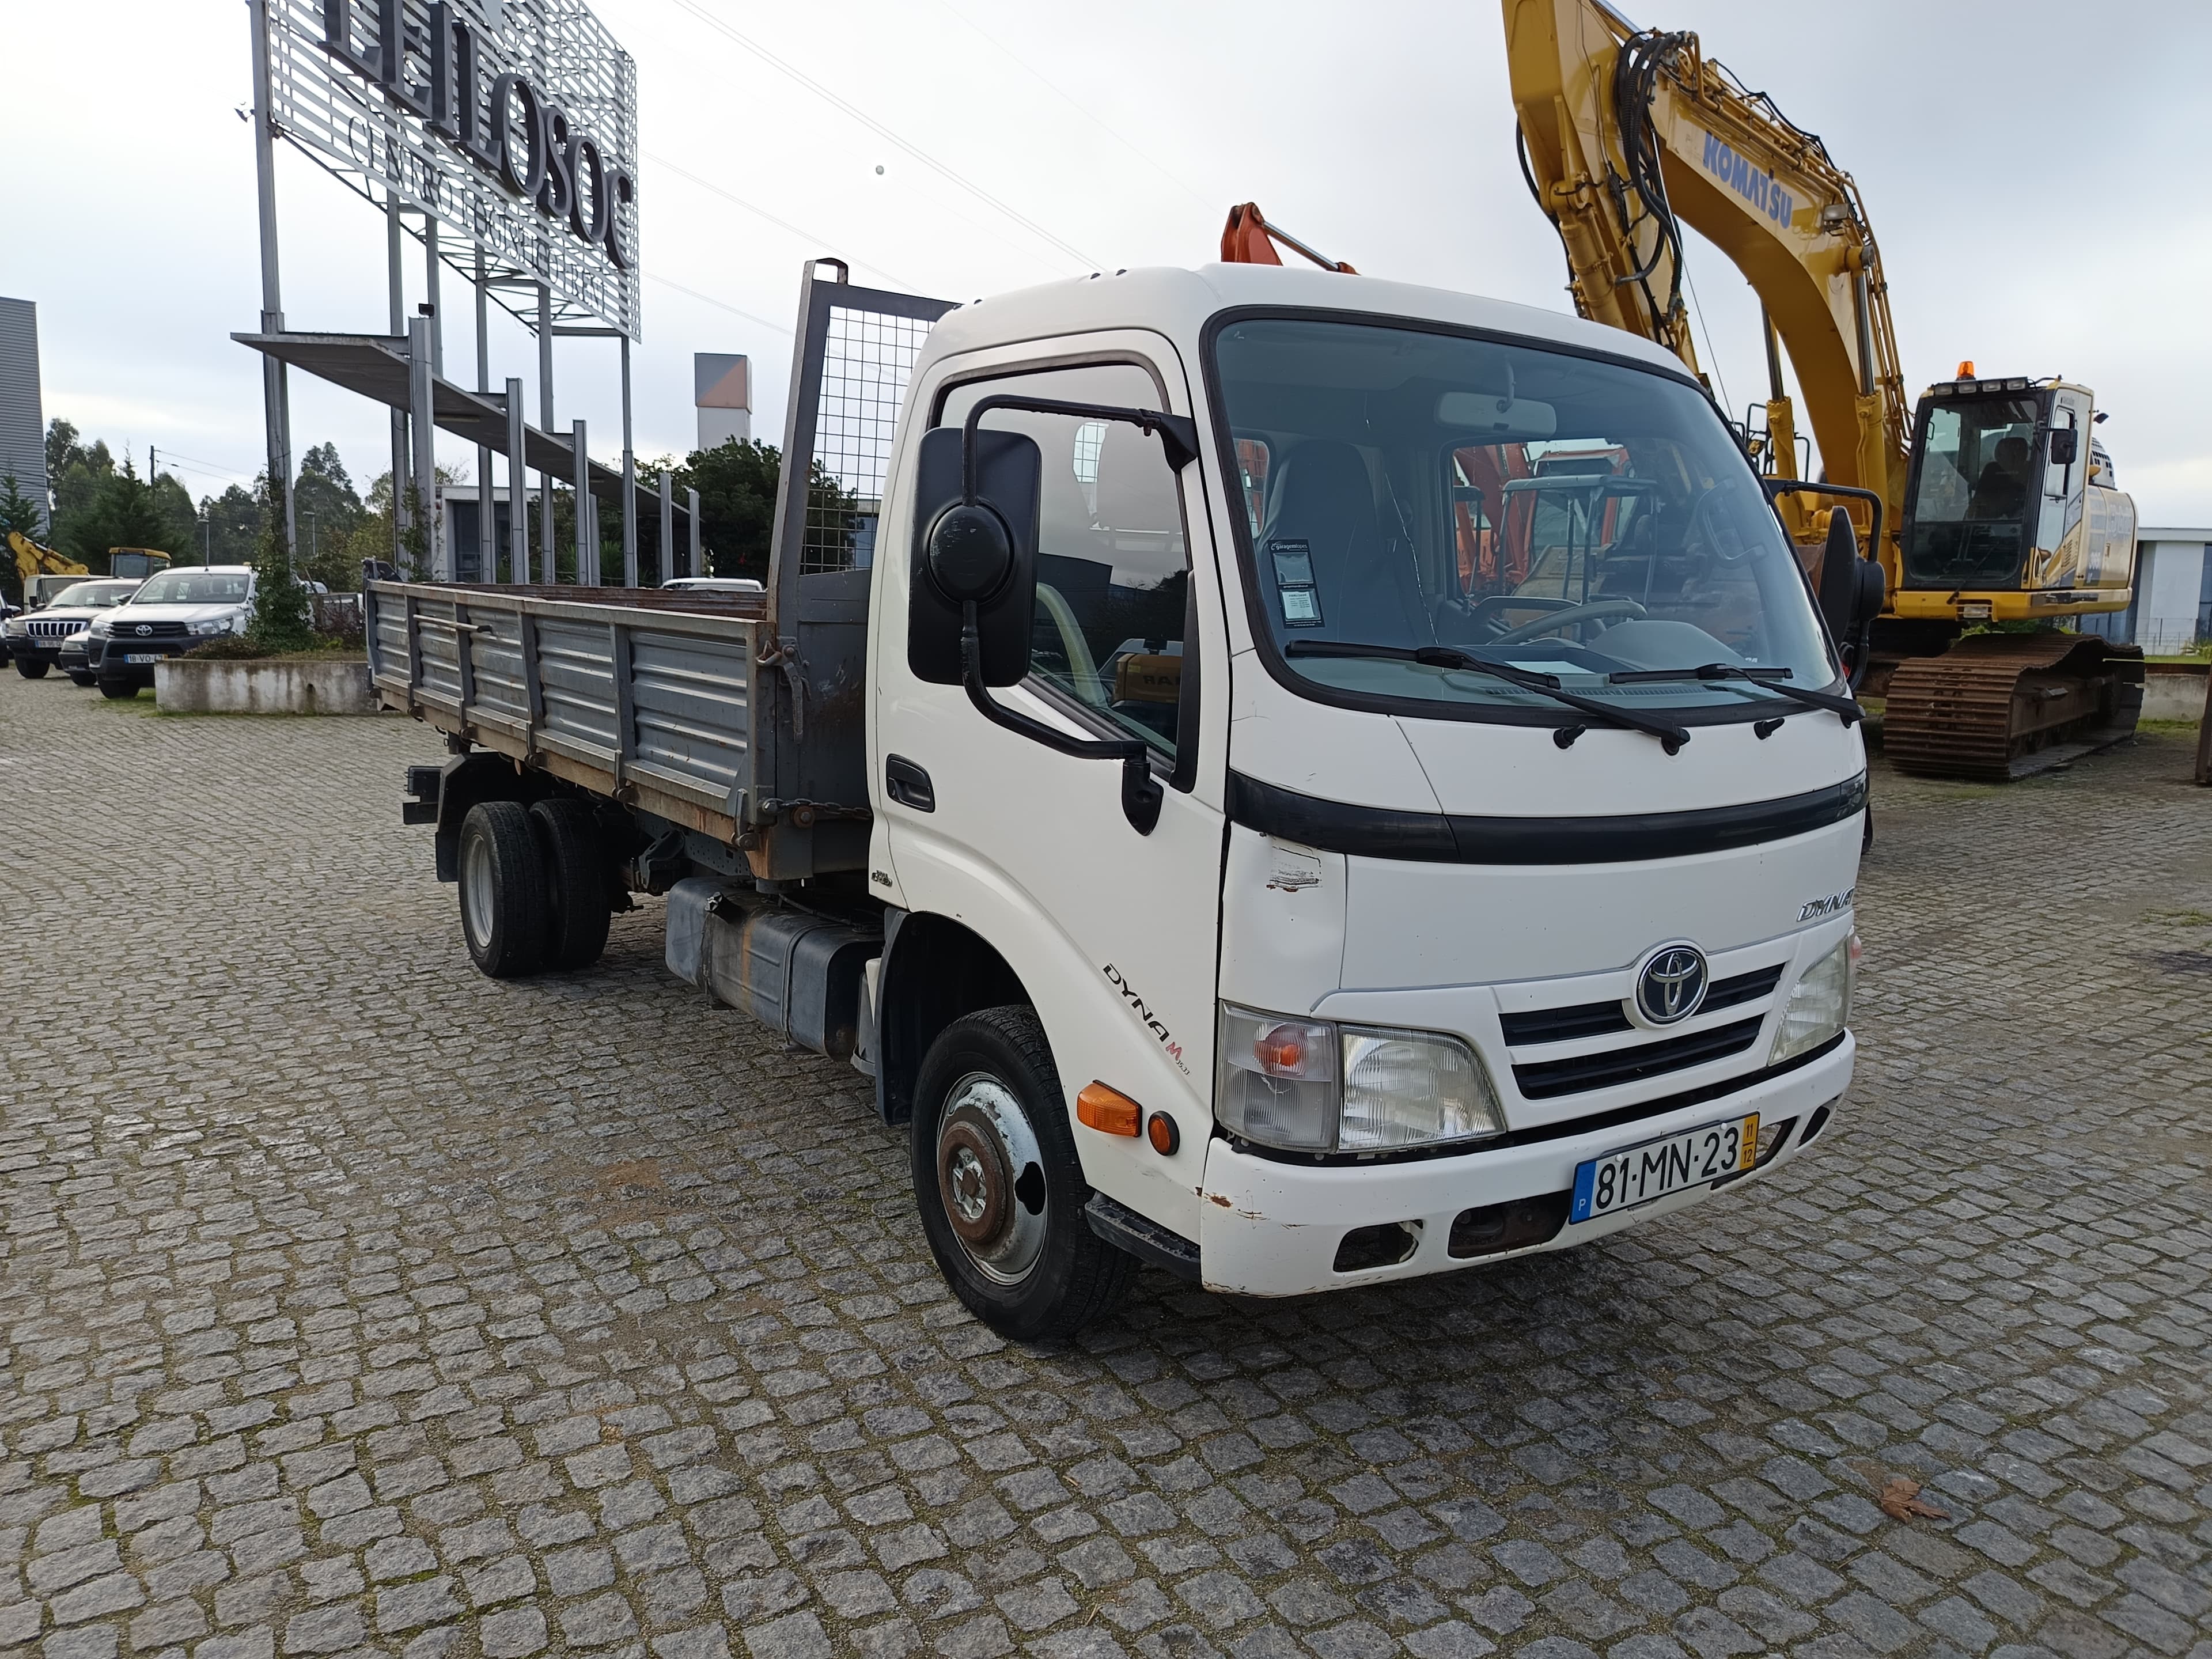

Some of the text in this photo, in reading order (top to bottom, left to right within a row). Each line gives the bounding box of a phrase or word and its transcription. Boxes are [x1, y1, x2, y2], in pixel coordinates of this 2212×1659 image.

[349, 116, 453, 217] CENTRO
[1703, 130, 1793, 229] KOMATSU
[1797, 886, 1855, 922] DYNA
[1103, 963, 1169, 1042] DYNA
[1745, 1124, 1754, 1138] 11
[1743, 1149, 1753, 1164] 12
[1578, 1198, 1586, 1211] P
